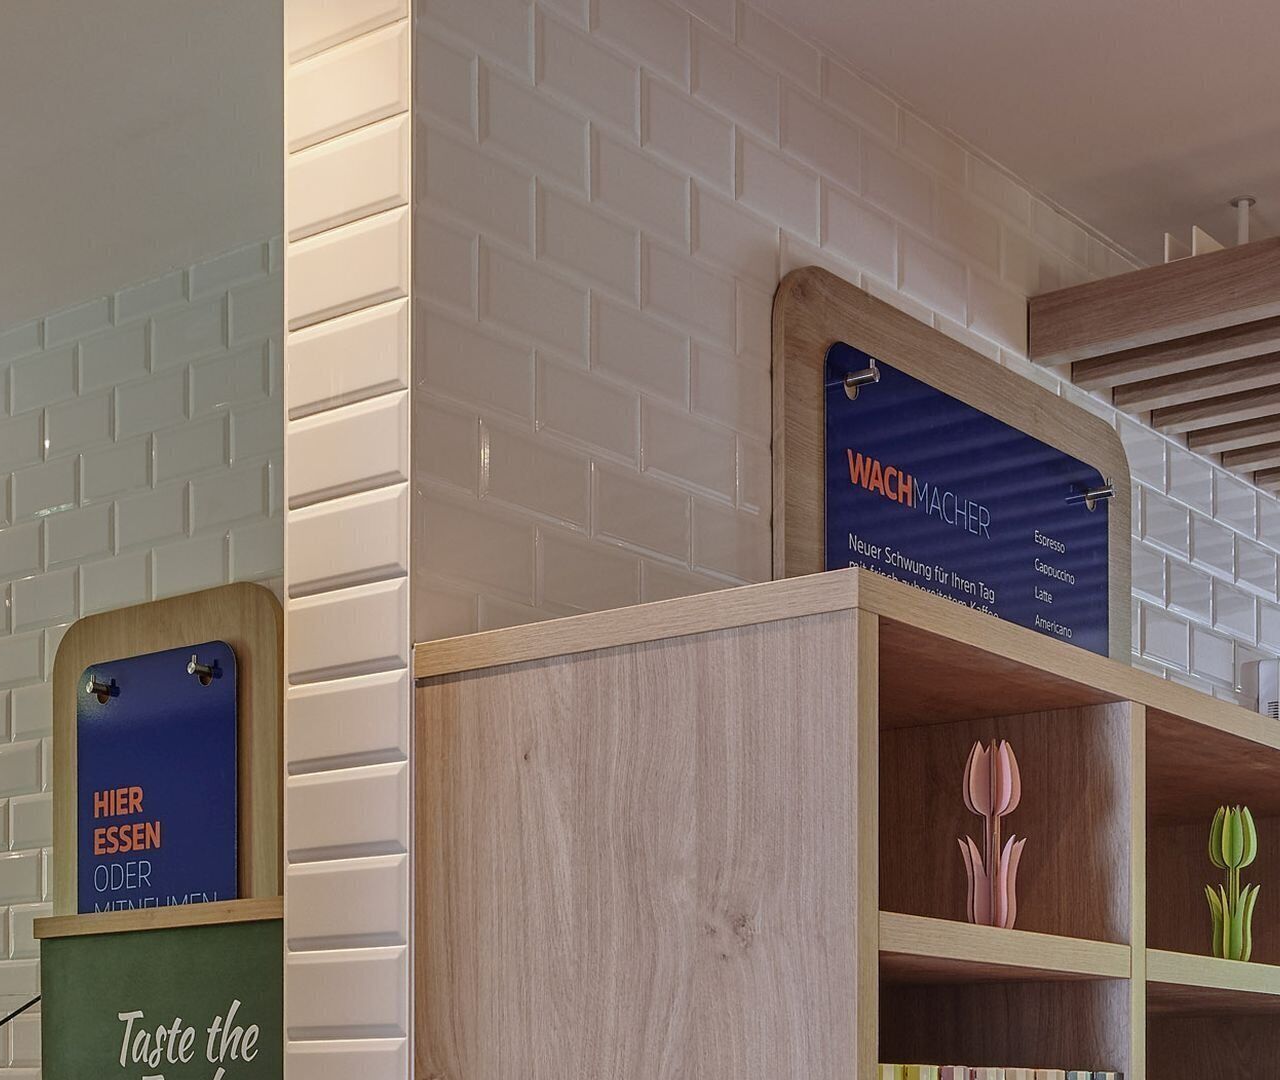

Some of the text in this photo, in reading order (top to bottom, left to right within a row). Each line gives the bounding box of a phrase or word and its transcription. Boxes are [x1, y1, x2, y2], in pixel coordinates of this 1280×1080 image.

[847, 448, 991, 540] WACHMACHER
[1034, 530, 1066, 554] Espresso
[849, 533, 882, 560] Neuer
[885, 547, 932, 580] Schwung
[934, 565, 949, 585] für
[951, 573, 977, 595] Ihren
[979, 582, 995, 603] Tag
[1034, 558, 1075, 585] Cappuccino
[1034, 586, 1053, 604] Latte
[1034, 614, 1073, 639] Americano
[94, 786, 144, 819] HIER
[94, 821, 161, 855] ESSEN
[94, 860, 152, 893] ODER
[118, 999, 260, 1069] Taste the
